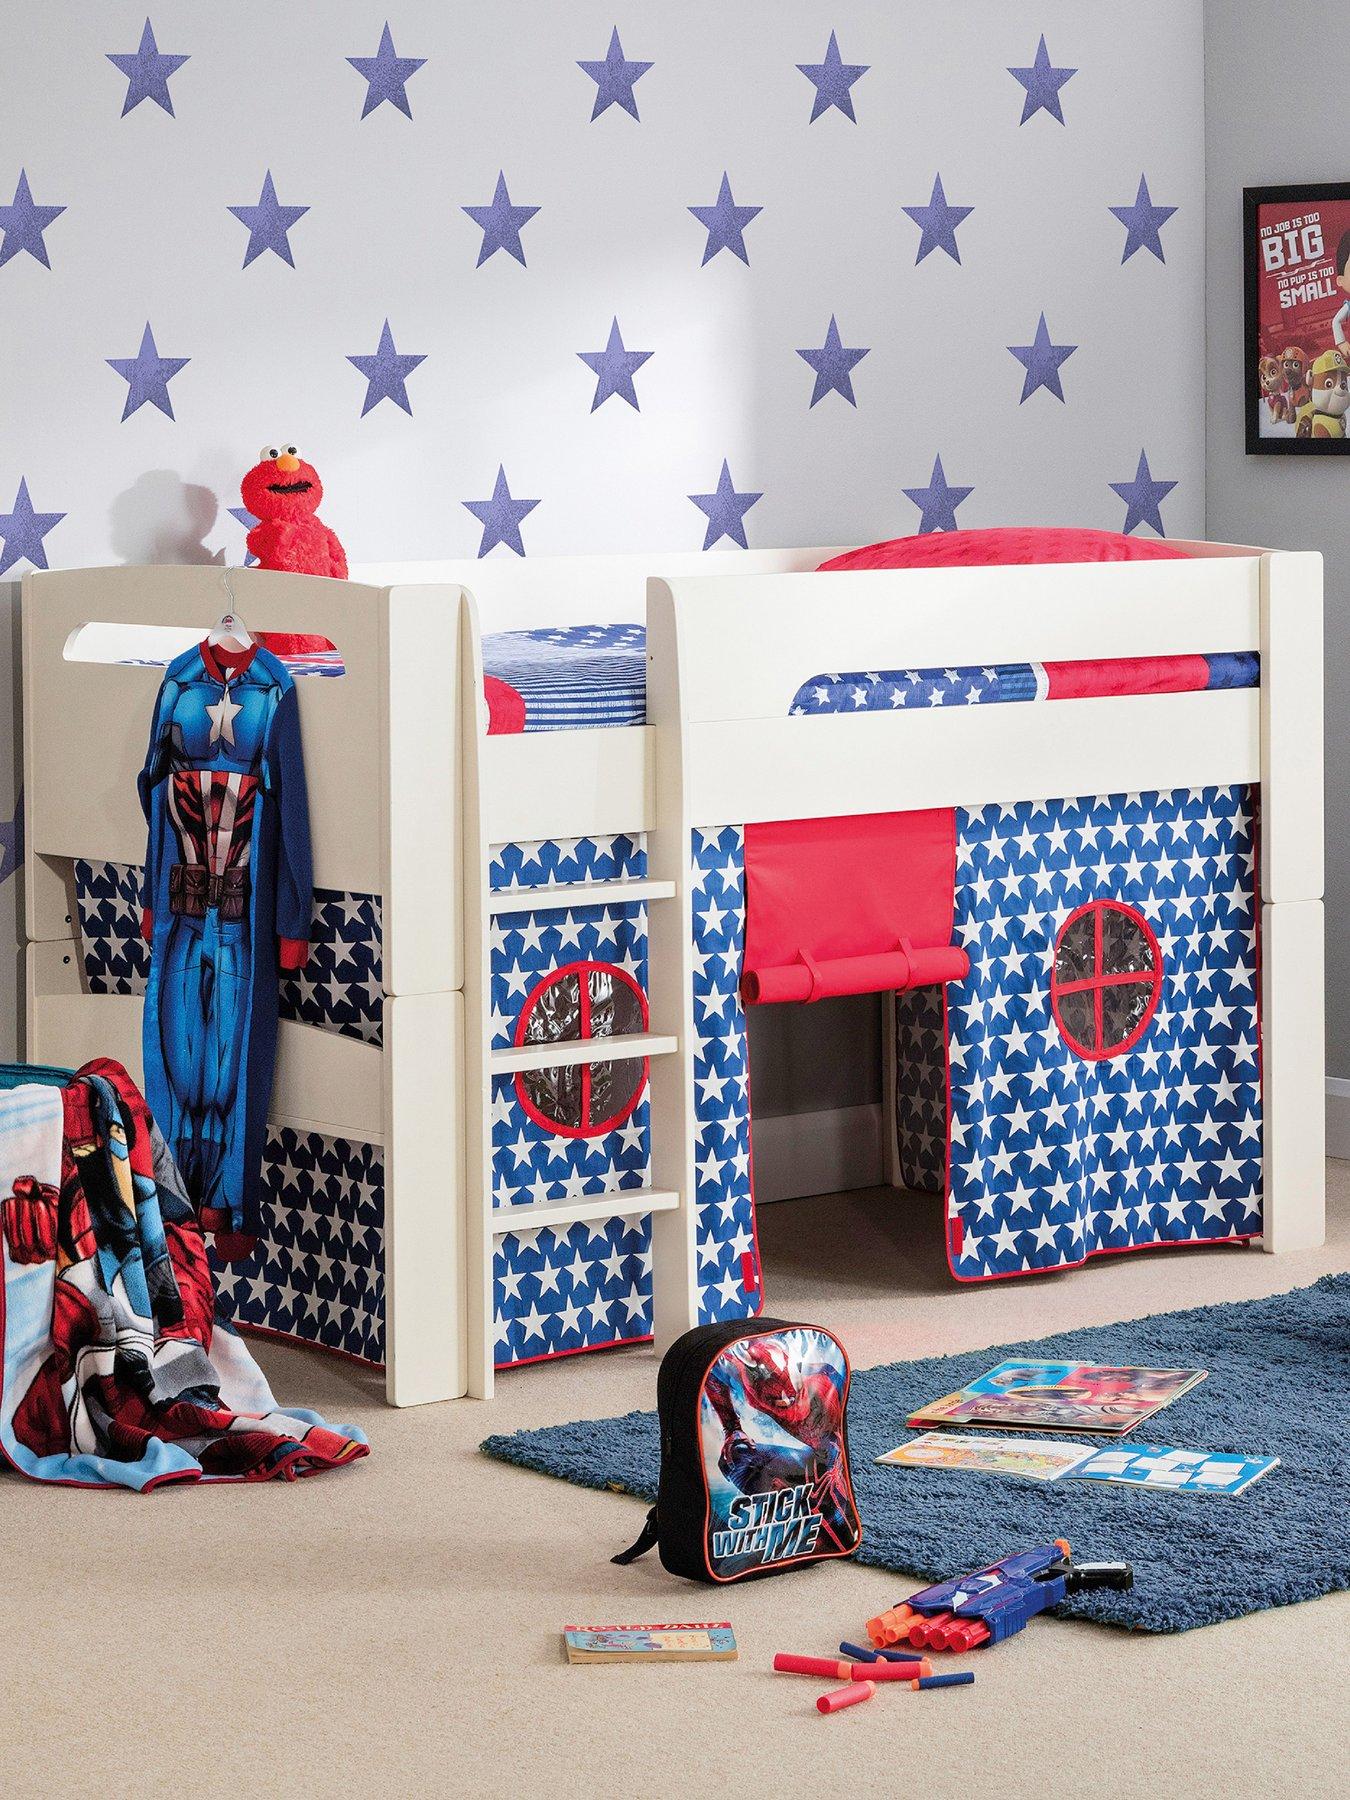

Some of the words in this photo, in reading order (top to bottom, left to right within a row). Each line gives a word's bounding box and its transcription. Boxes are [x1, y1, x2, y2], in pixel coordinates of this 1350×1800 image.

[1261, 226, 1272, 237] NO
[1274, 221, 1290, 232] JOB
[1292, 217, 1302, 228] IS
[1303, 212, 1319, 224] TOO
[1262, 224, 1324, 272] BIG
[1278, 279, 1289, 289] NO
[1291, 275, 1306, 285] PUP
[1308, 270, 1318, 281] IS
[1319, 267, 1334, 277] TOO
[1279, 278, 1337, 309] SMALL
[728, 1482, 814, 1531] STICK
[713, 1526, 769, 1558] WITH
[761, 1514, 823, 1564] ME
